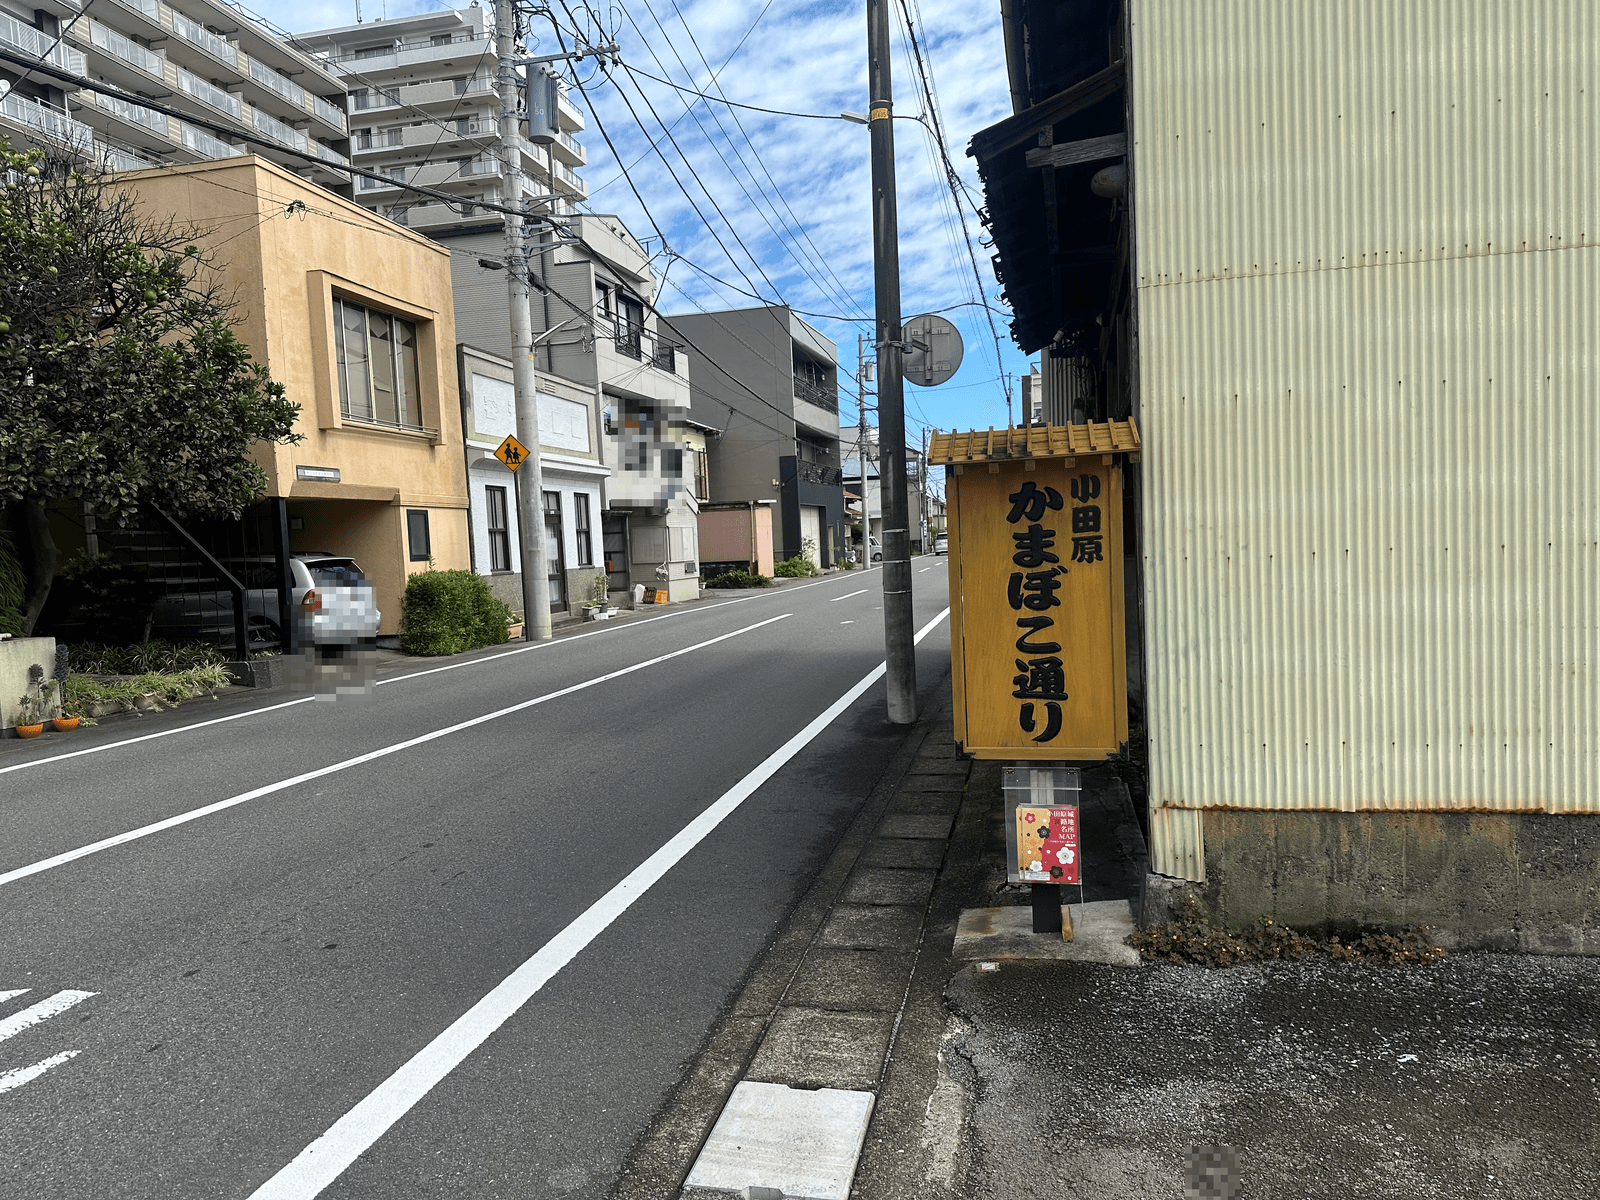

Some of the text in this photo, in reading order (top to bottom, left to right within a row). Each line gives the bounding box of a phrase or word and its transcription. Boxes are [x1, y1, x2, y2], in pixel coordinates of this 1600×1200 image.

[1071, 474, 1103, 564] 小田原
[1006, 481, 1068, 743] かまぼこ通り
